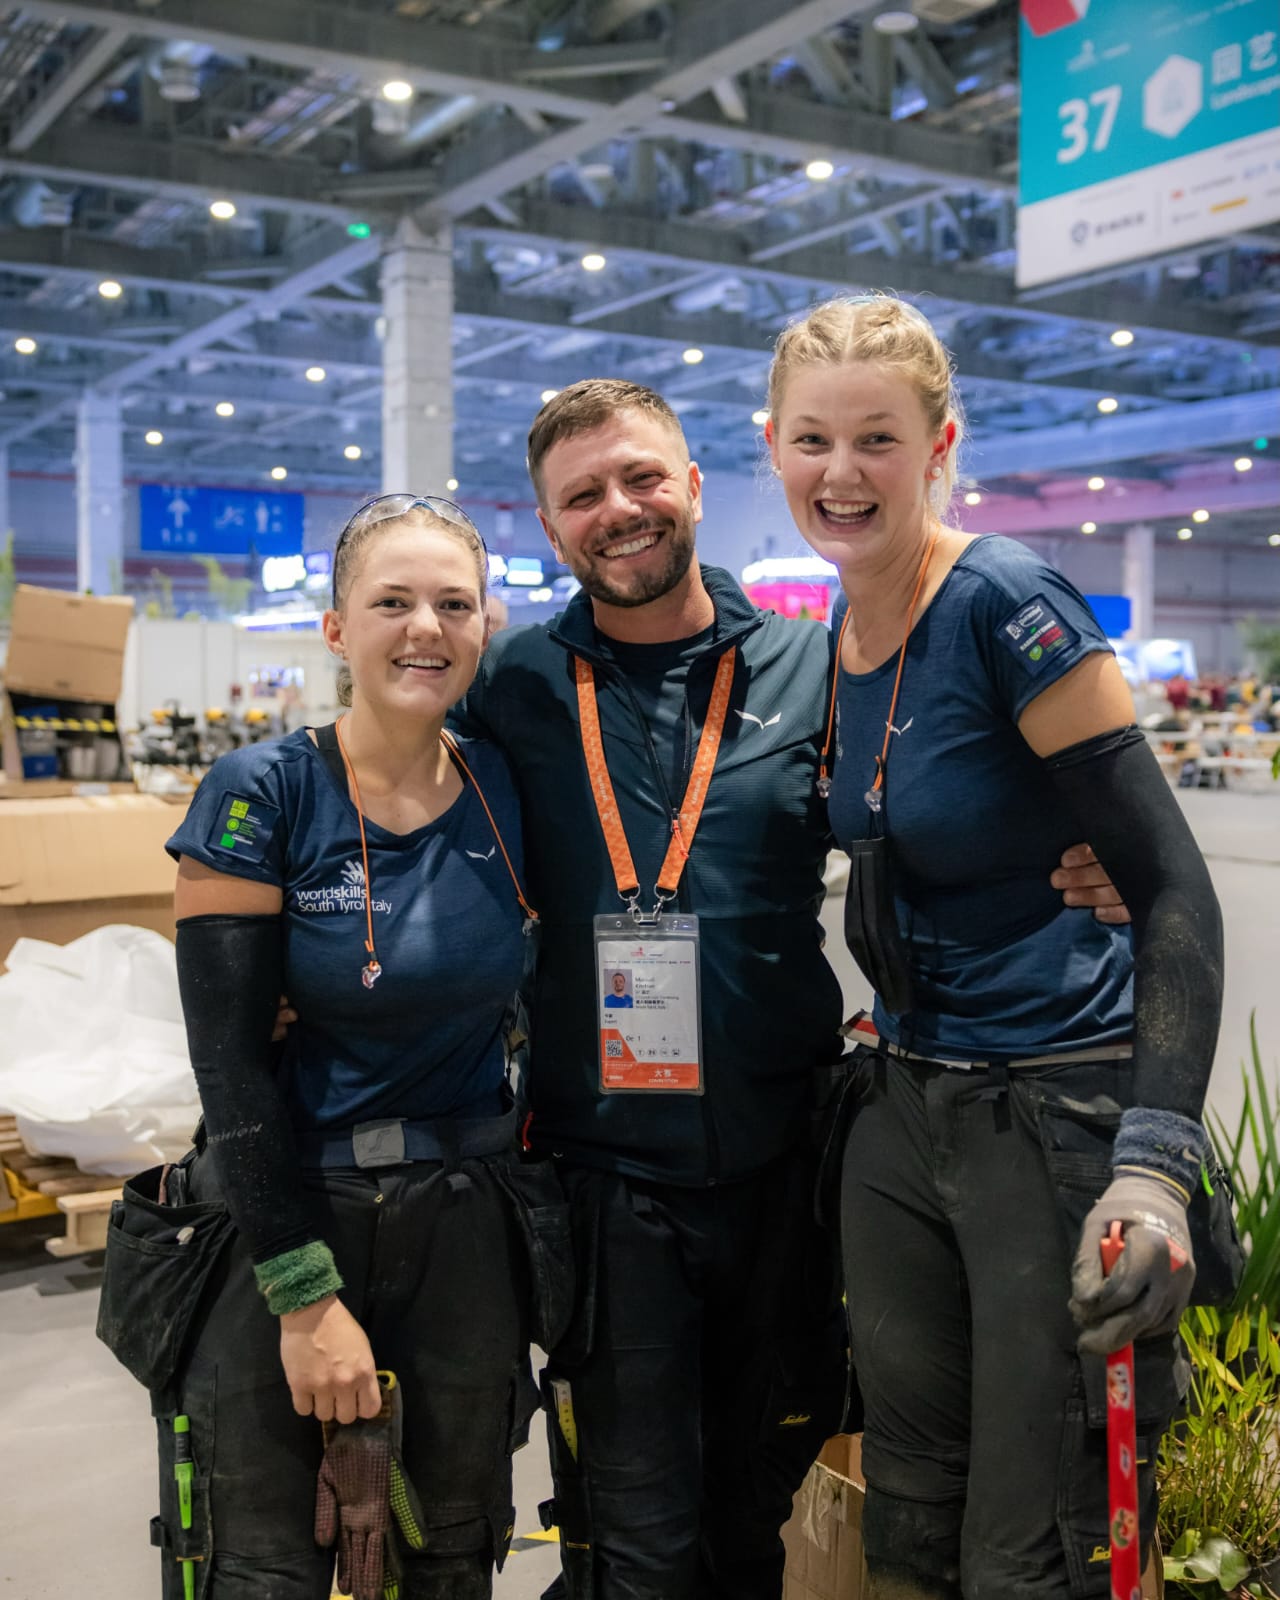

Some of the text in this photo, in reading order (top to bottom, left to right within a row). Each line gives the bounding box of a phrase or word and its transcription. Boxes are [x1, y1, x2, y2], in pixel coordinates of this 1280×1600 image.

[1057, 85, 1122, 163] 37
[296, 886, 367, 900] worldskills
[298, 899, 393, 914] South Tyrol taly
